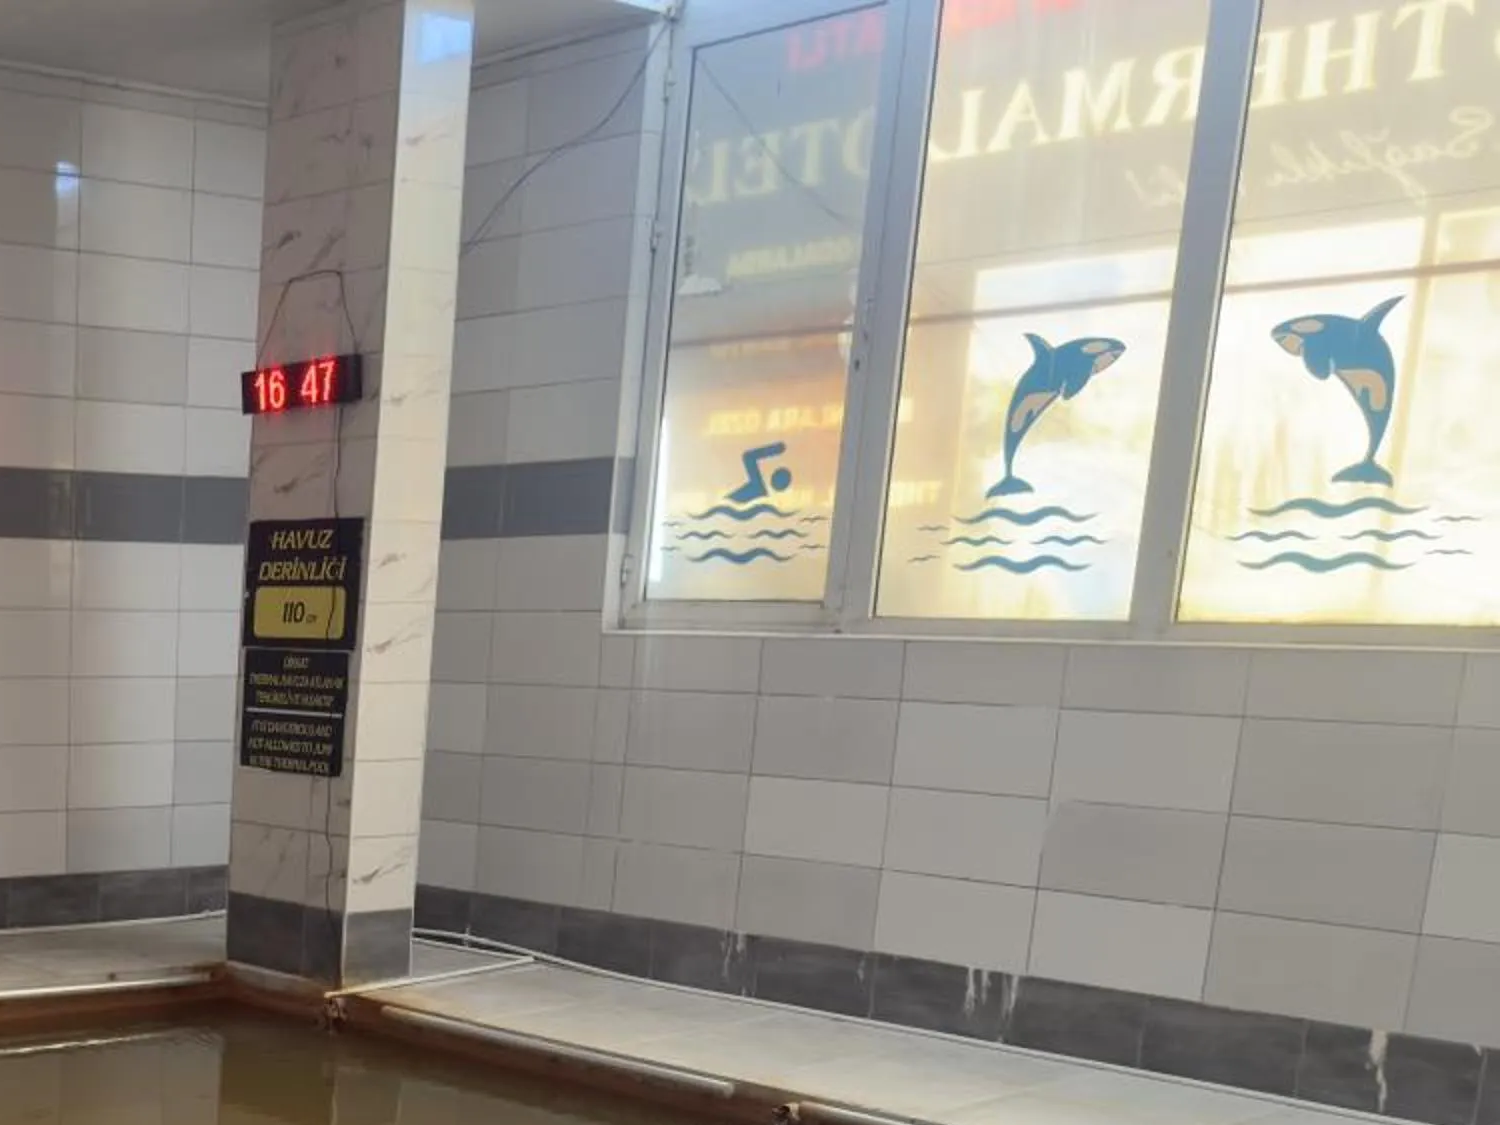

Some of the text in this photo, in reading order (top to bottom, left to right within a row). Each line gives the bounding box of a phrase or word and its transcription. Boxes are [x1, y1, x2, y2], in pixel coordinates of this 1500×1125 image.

[254, 360, 336, 411] 16 47
[270, 529, 334, 550] HAVUZ
[282, 601, 306, 624] 110
